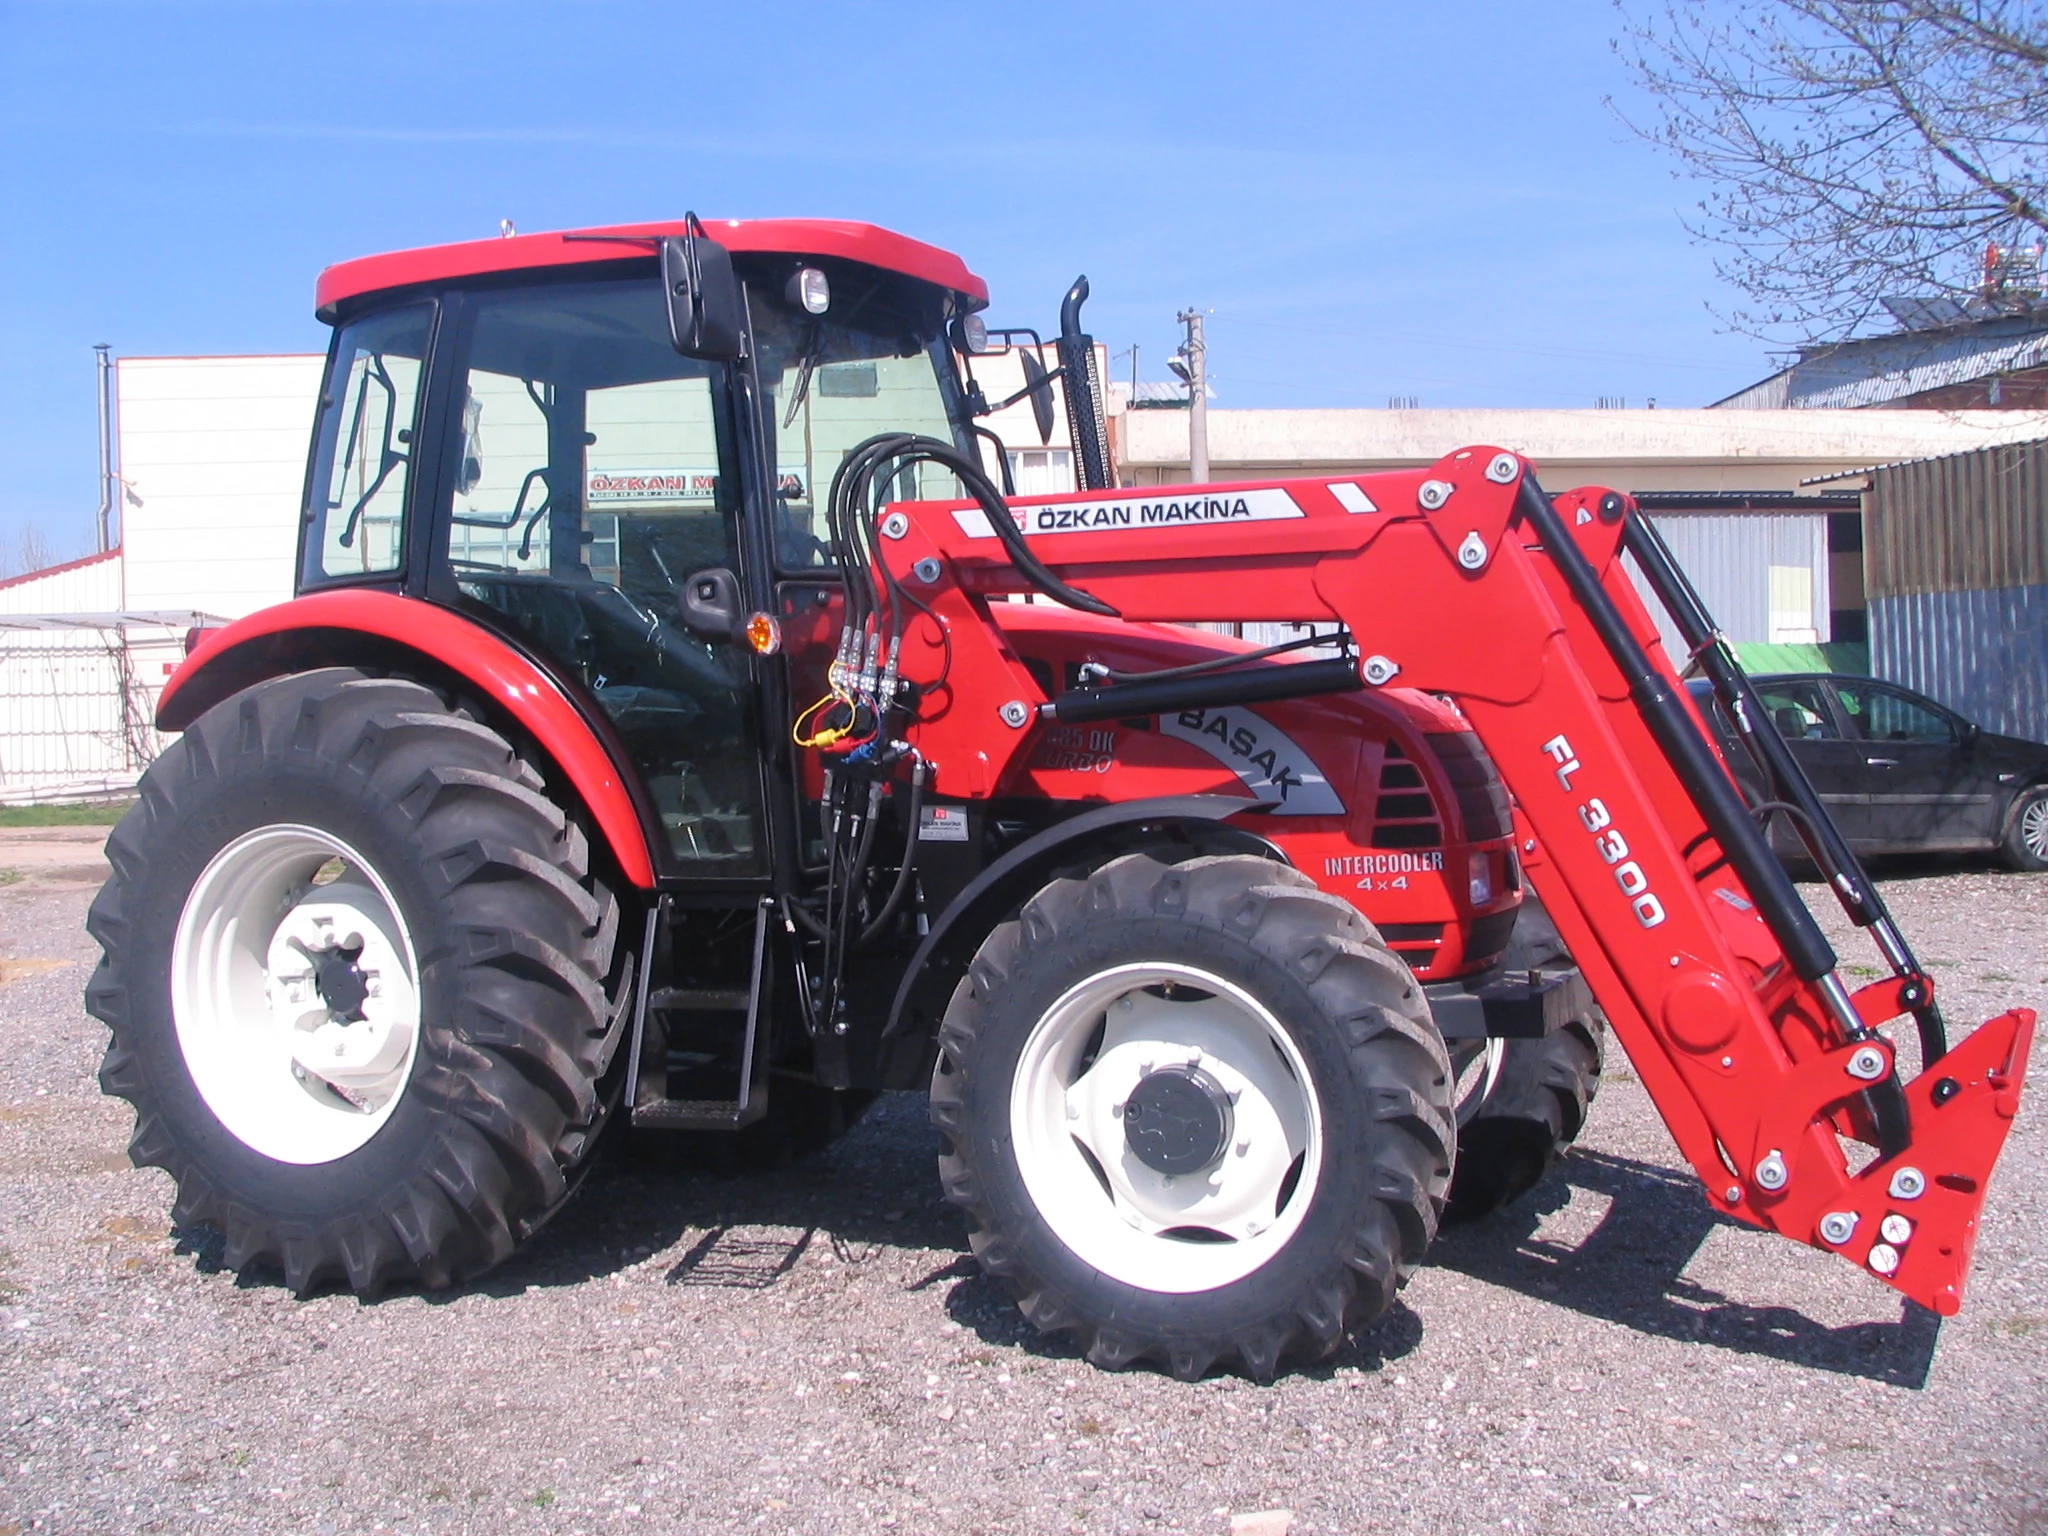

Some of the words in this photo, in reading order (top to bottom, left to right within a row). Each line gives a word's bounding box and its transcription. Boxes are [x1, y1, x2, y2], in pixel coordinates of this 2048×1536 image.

[590, 475, 686, 491] ÖZKAN
[1037, 507, 1131, 530] ÖZKAN
[1140, 497, 1251, 524] MAKİNA
[1089, 729, 1116, 753] DK
[1178, 709, 1303, 801] BAŞAK
[1541, 733, 1581, 792] FL
[1577, 797, 1667, 929] 3300
[1324, 851, 1444, 876] INTERCOOLER
